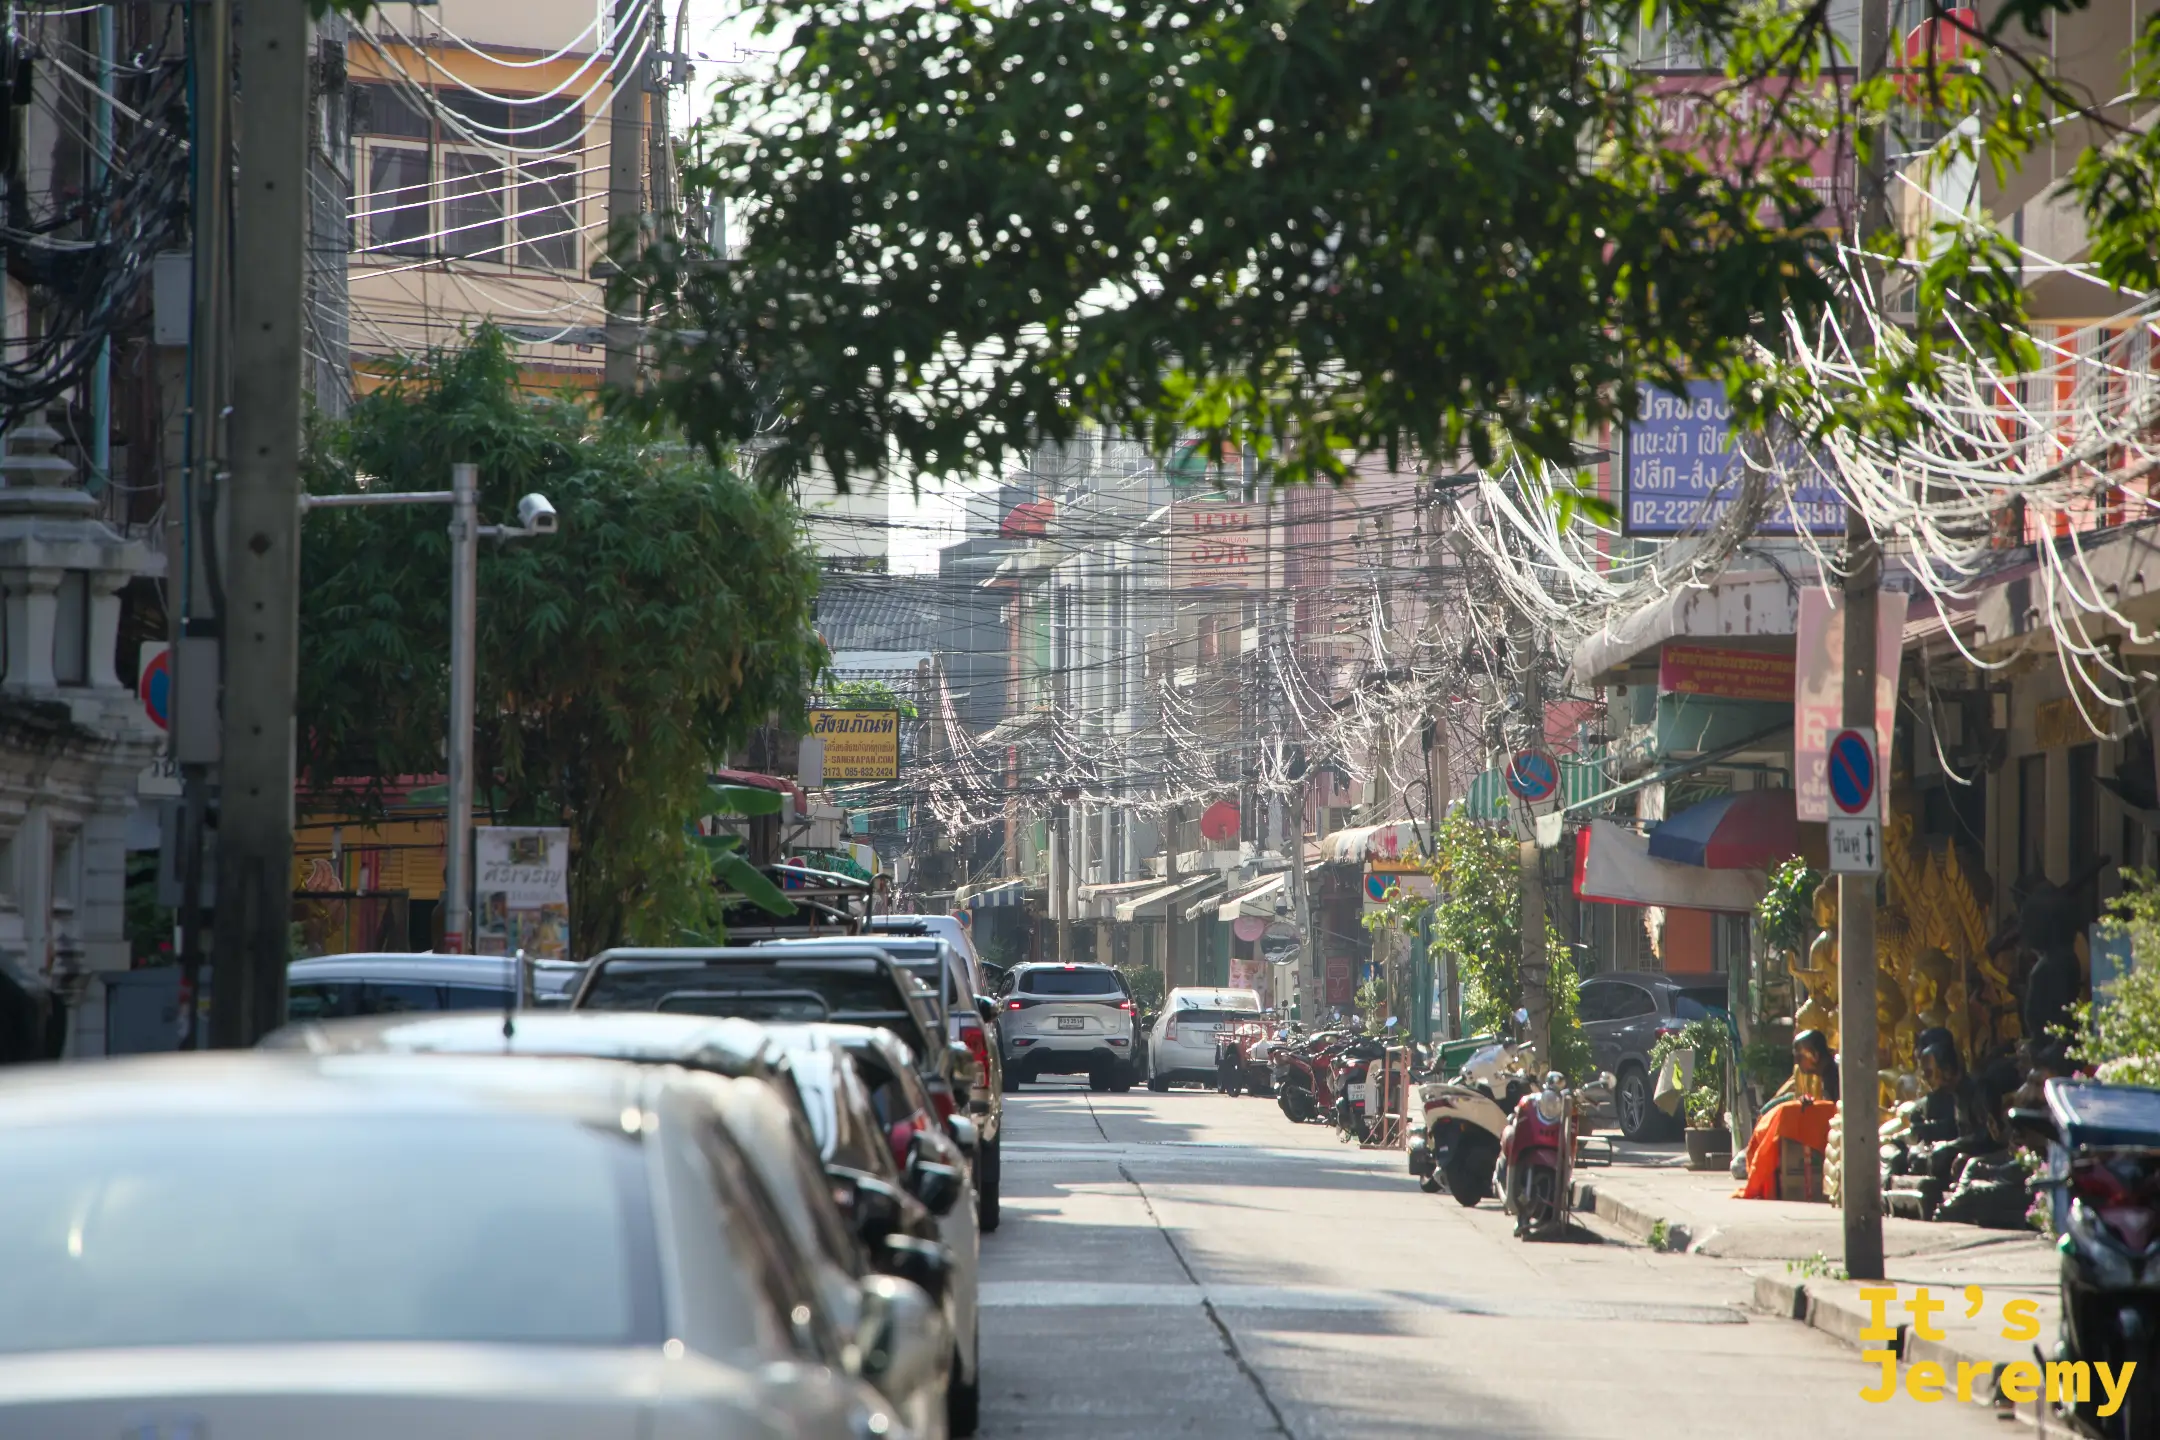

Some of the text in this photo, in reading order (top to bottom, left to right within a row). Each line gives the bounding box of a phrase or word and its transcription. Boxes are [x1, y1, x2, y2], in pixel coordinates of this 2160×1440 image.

[1633, 425, 1688, 456] แนะนำ
[813, 713, 894, 734] สังฆภัณฑ์
